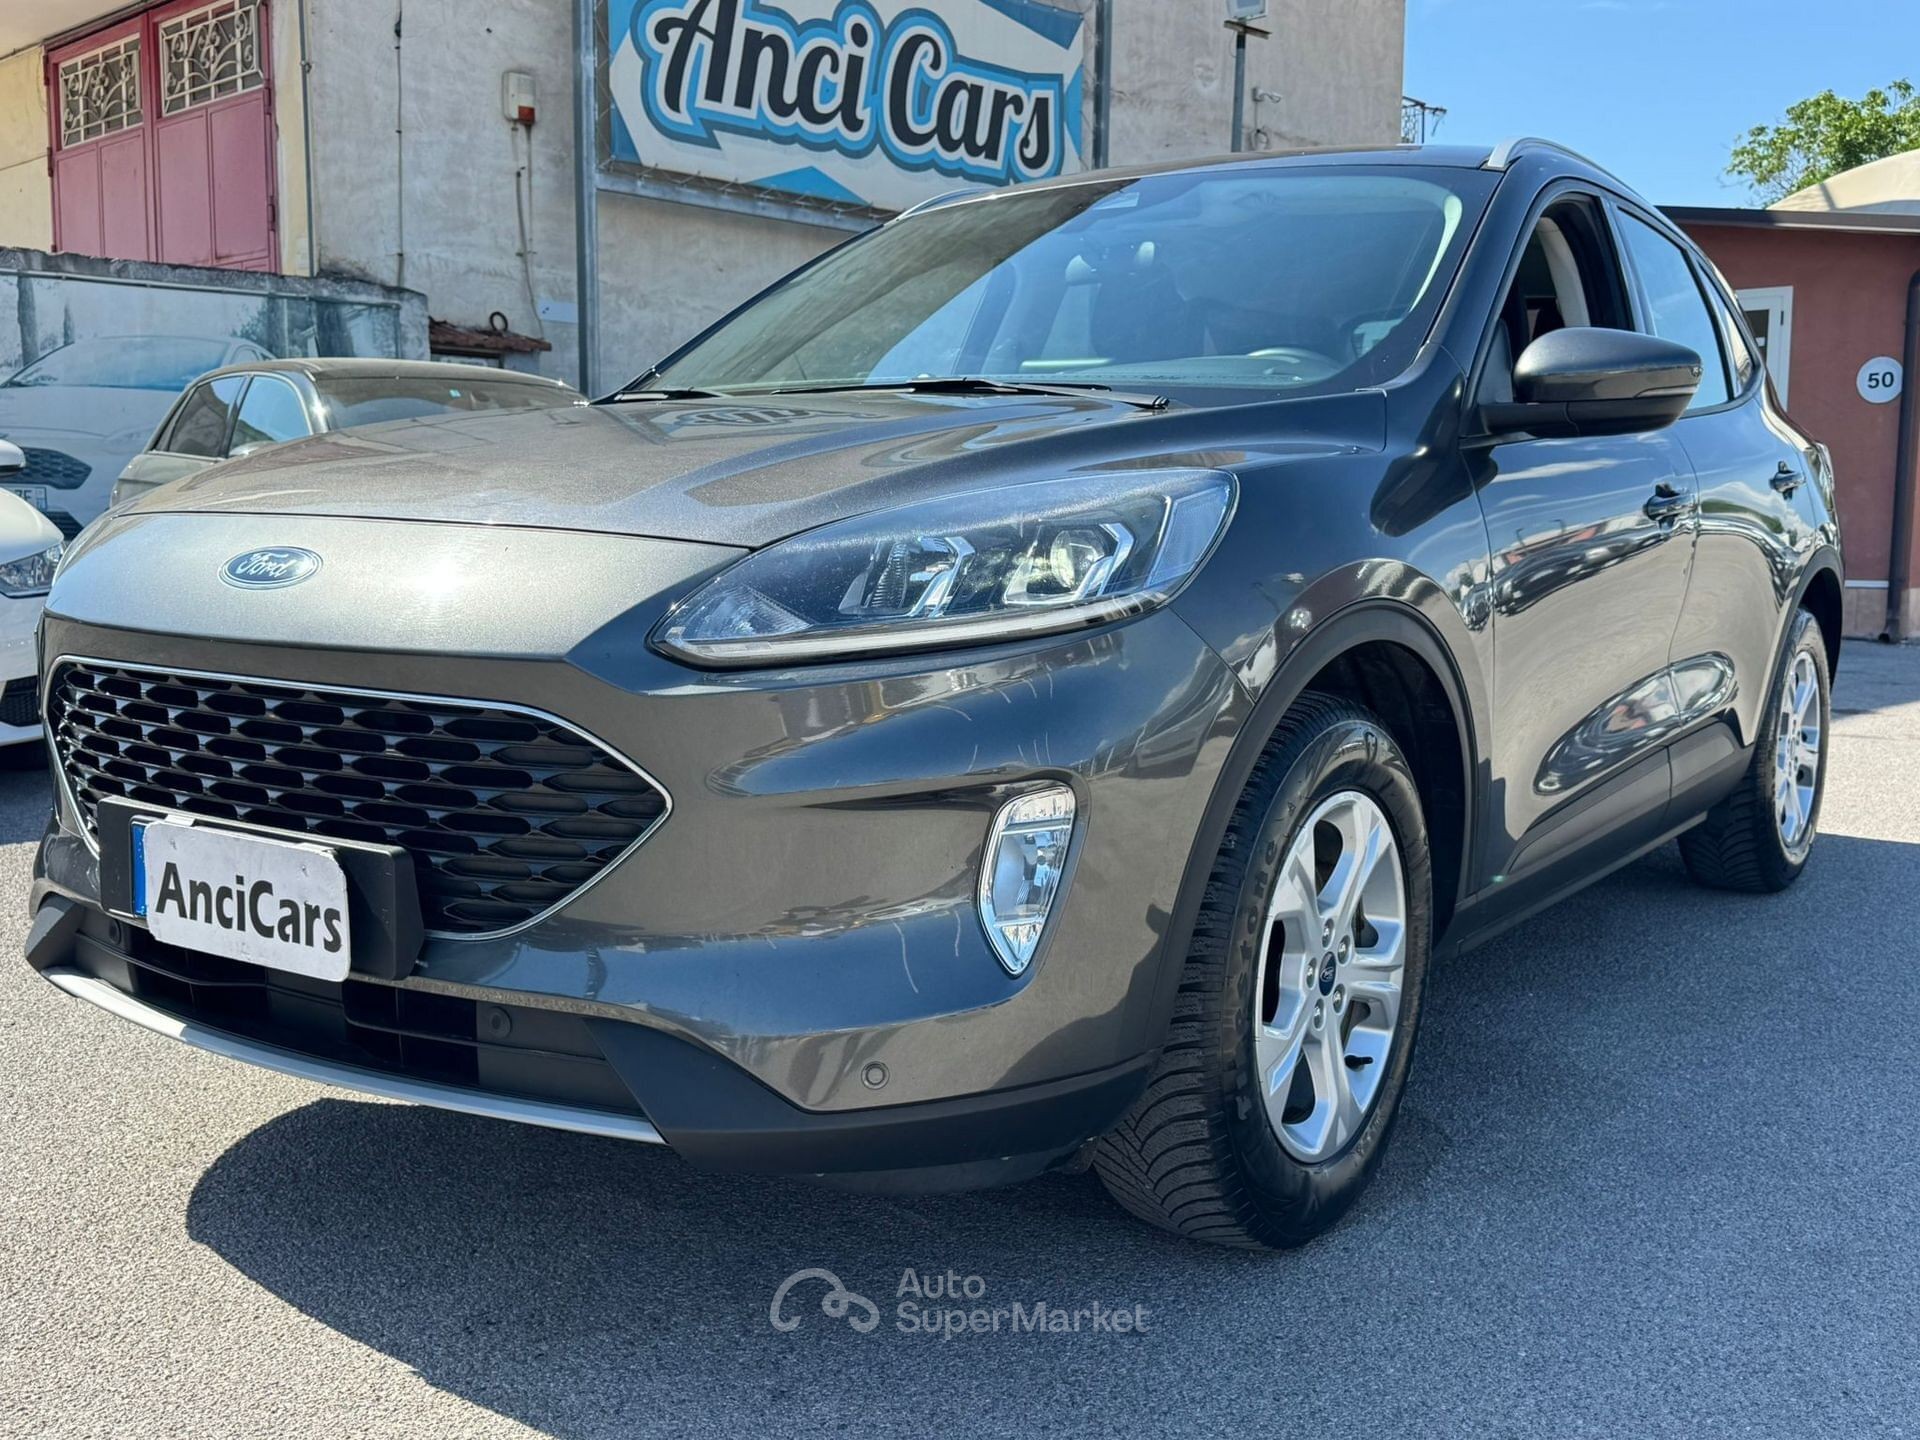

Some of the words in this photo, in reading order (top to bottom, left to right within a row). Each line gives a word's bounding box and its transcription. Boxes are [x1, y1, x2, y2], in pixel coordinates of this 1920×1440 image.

[654, 0, 868, 132] Anci
[889, 33, 1050, 170] Cars
[1867, 371, 1895, 389] 50
[235, 552, 298, 578] Ford
[155, 861, 342, 953] AnciCars
